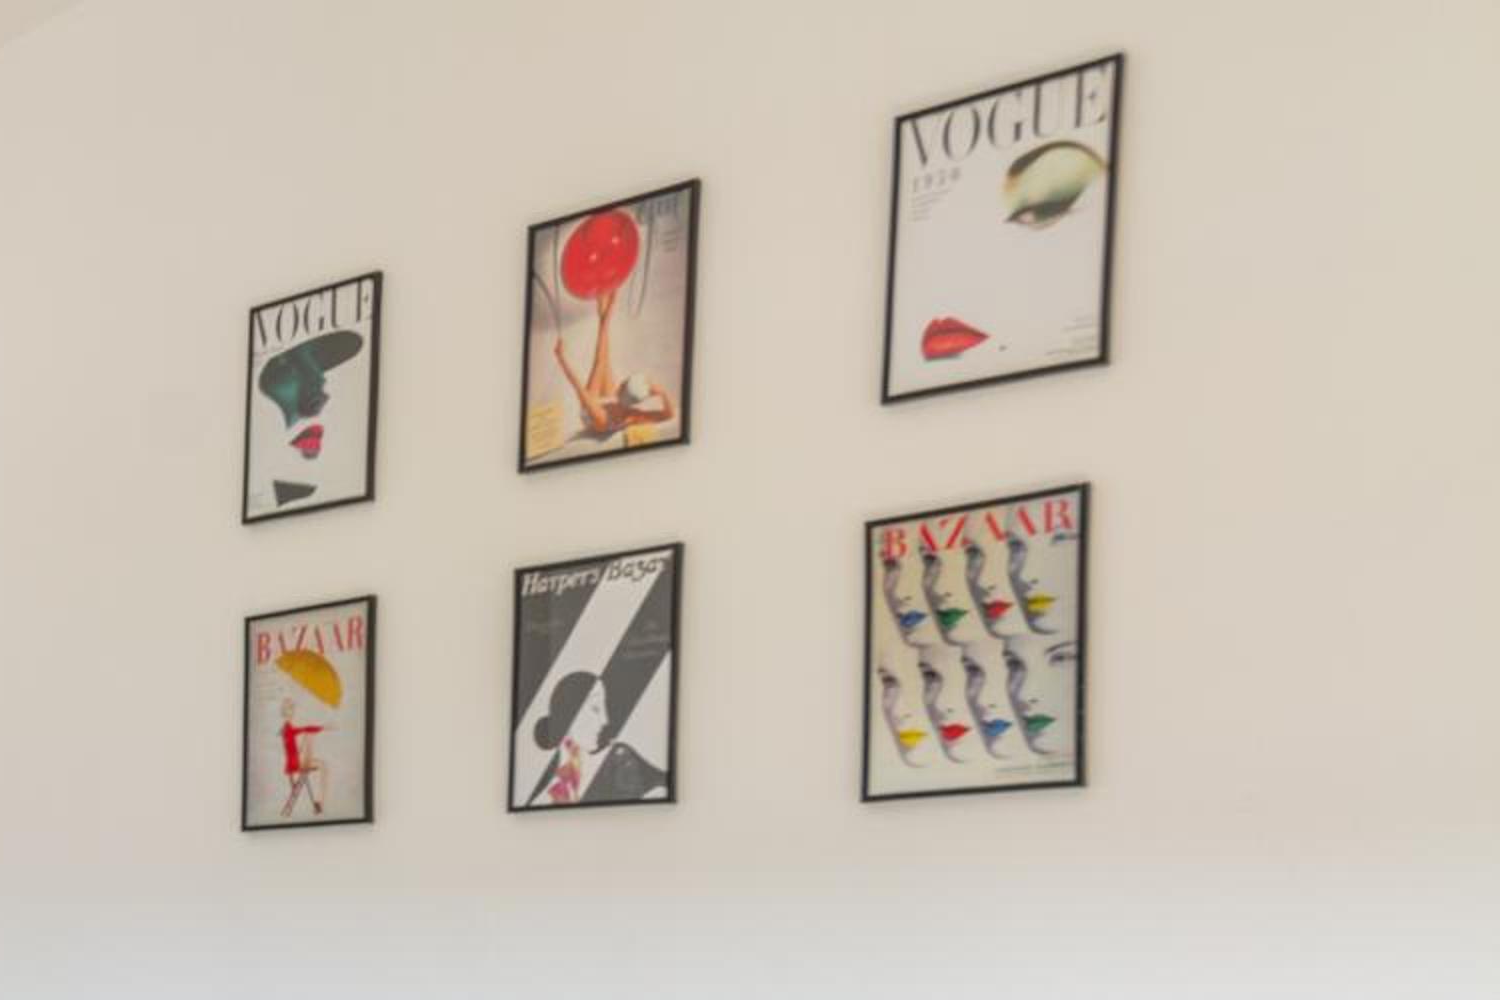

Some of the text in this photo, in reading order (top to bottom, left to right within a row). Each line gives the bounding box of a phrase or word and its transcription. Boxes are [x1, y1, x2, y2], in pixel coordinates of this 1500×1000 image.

[909, 64, 1106, 167] VOGUE
[256, 280, 372, 346] VOGUE
[880, 500, 1073, 560] BAZAAR
[257, 615, 365, 665] BAZAAR
